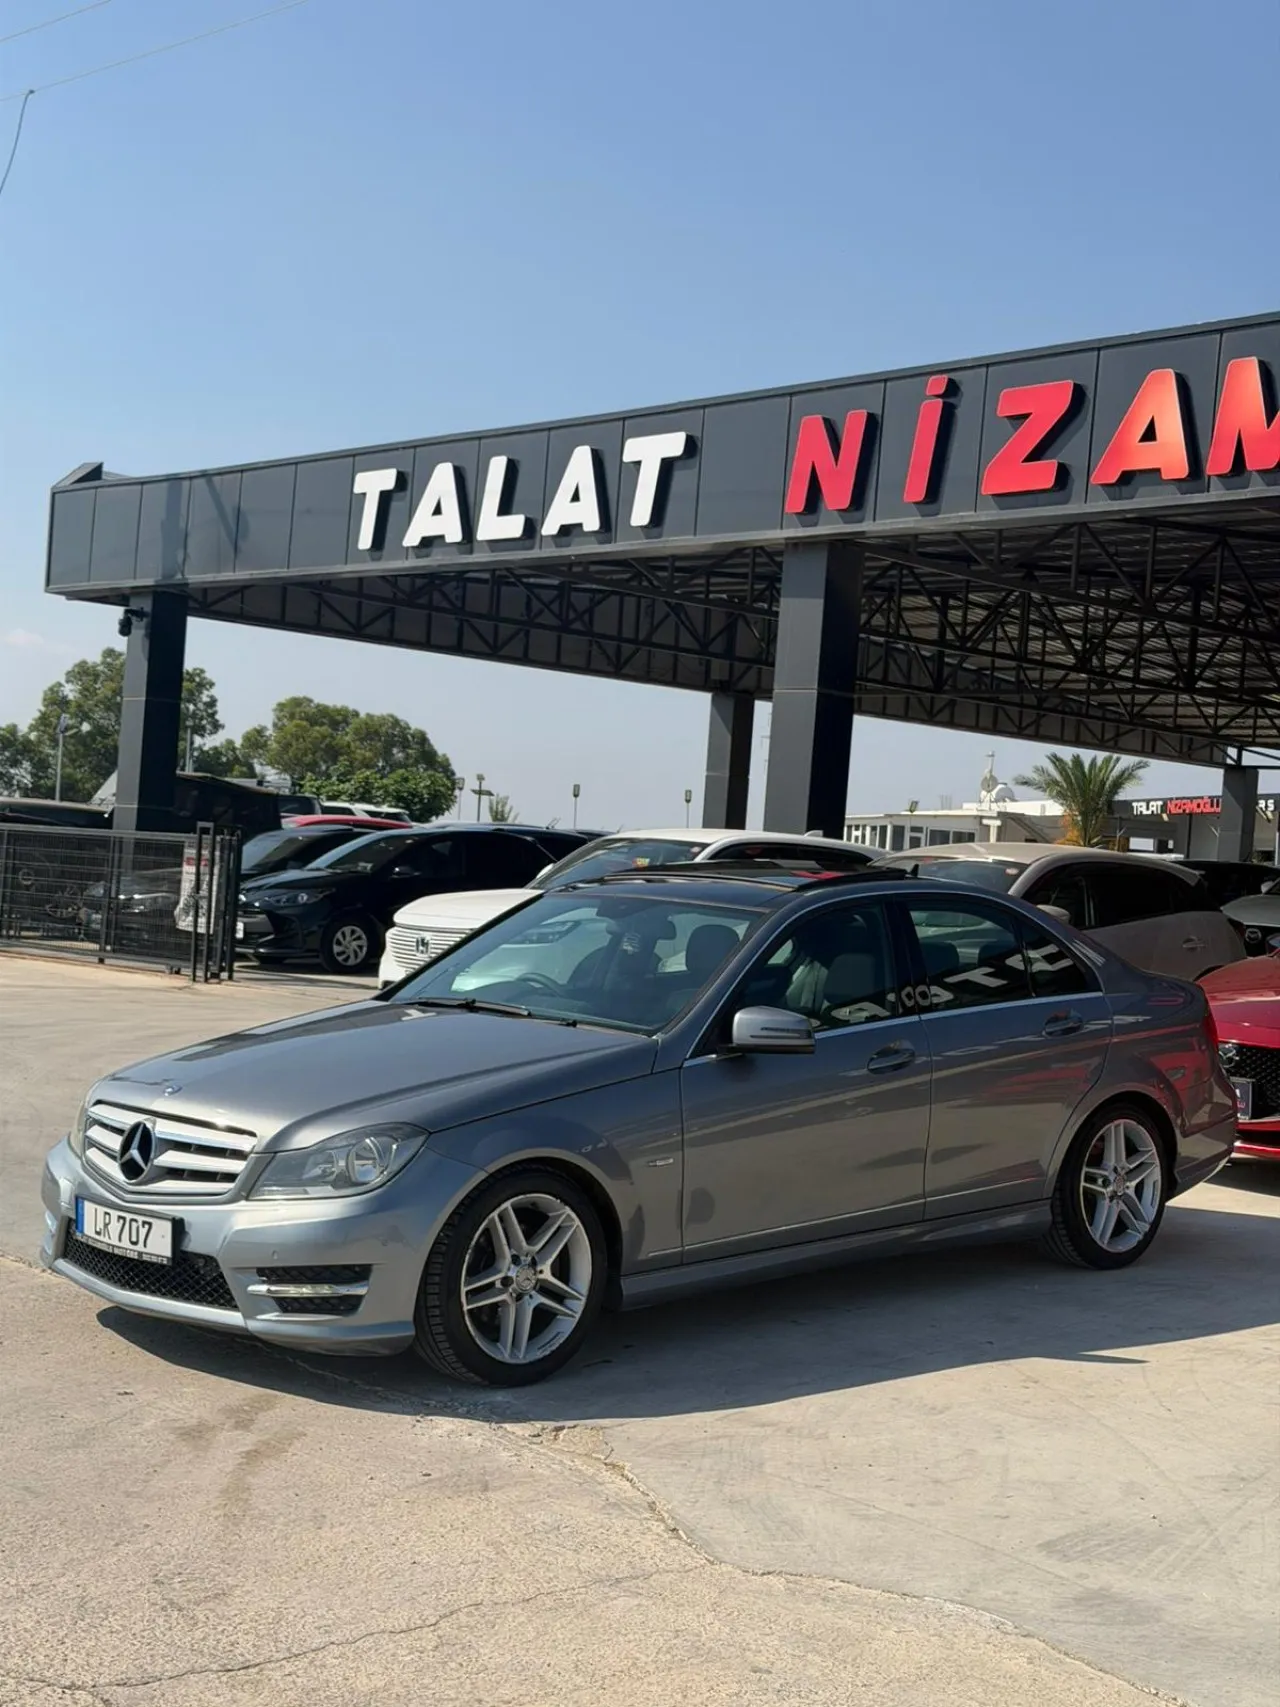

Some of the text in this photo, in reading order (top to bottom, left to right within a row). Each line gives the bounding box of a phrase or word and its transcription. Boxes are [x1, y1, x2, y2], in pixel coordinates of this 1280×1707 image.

[353, 356, 1280, 550] TALAT NİZAM
[1132, 800, 1163, 815] TALAT
[93, 1207, 112, 1241] LR
[116, 1215, 153, 1249] 707
